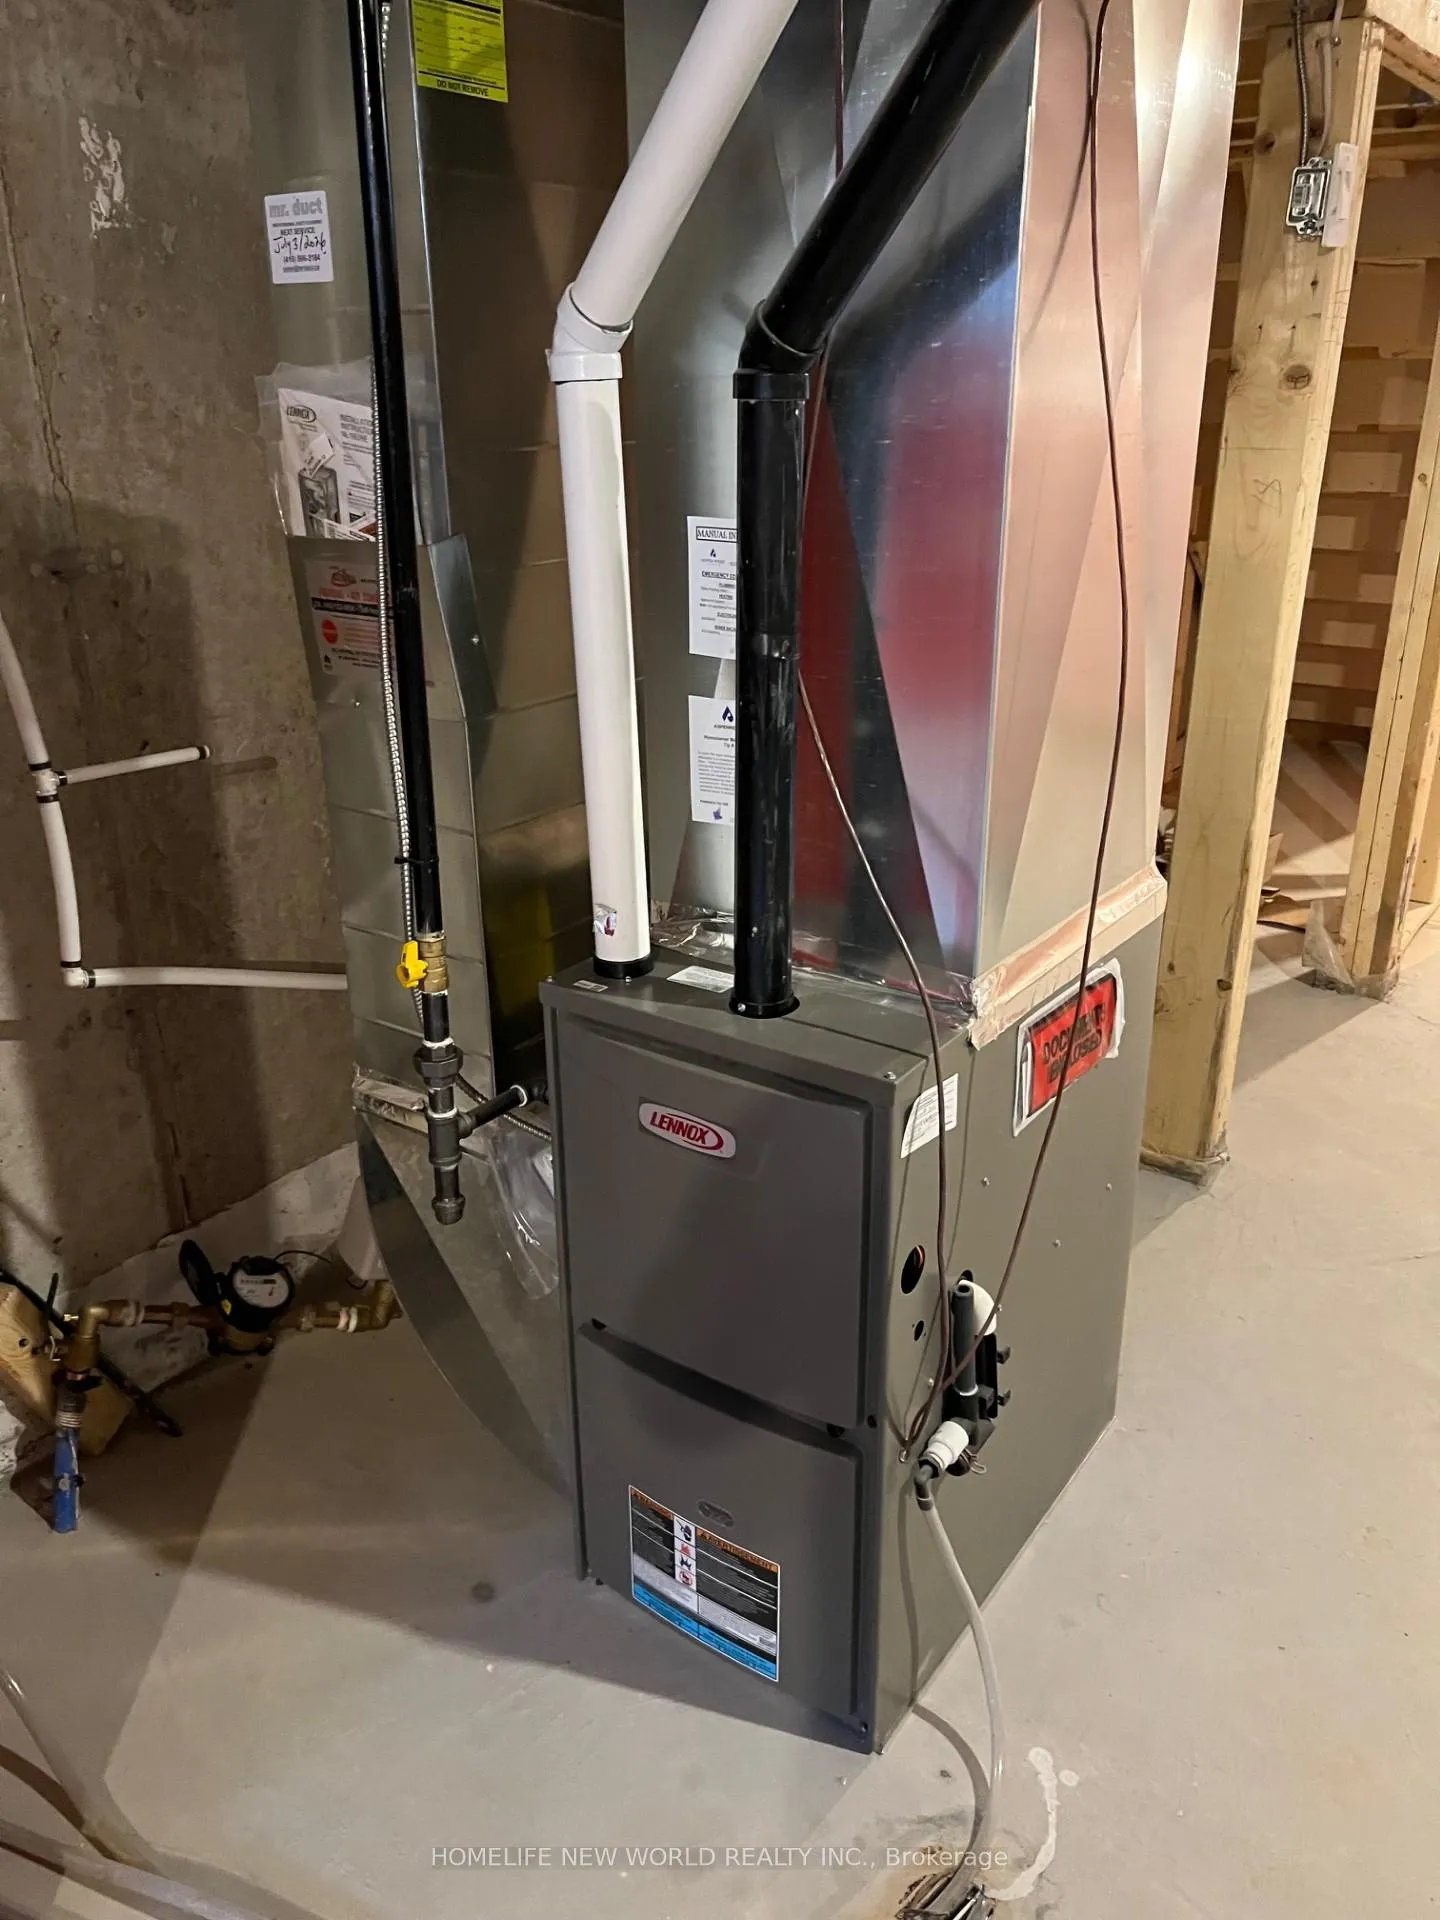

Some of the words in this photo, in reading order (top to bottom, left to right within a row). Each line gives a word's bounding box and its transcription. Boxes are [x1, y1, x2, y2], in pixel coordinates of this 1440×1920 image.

[436, 80, 446, 88] DO
[448, 81, 461, 91] NOT
[462, 84, 488, 97] REMOVE
[269, 204, 290, 217] mr.
[292, 197, 323, 216] duct
[697, 529, 726, 539] MANUAL
[1047, 1028, 1102, 1084] ENOSED
[650, 1111, 709, 1145] LENNOX
